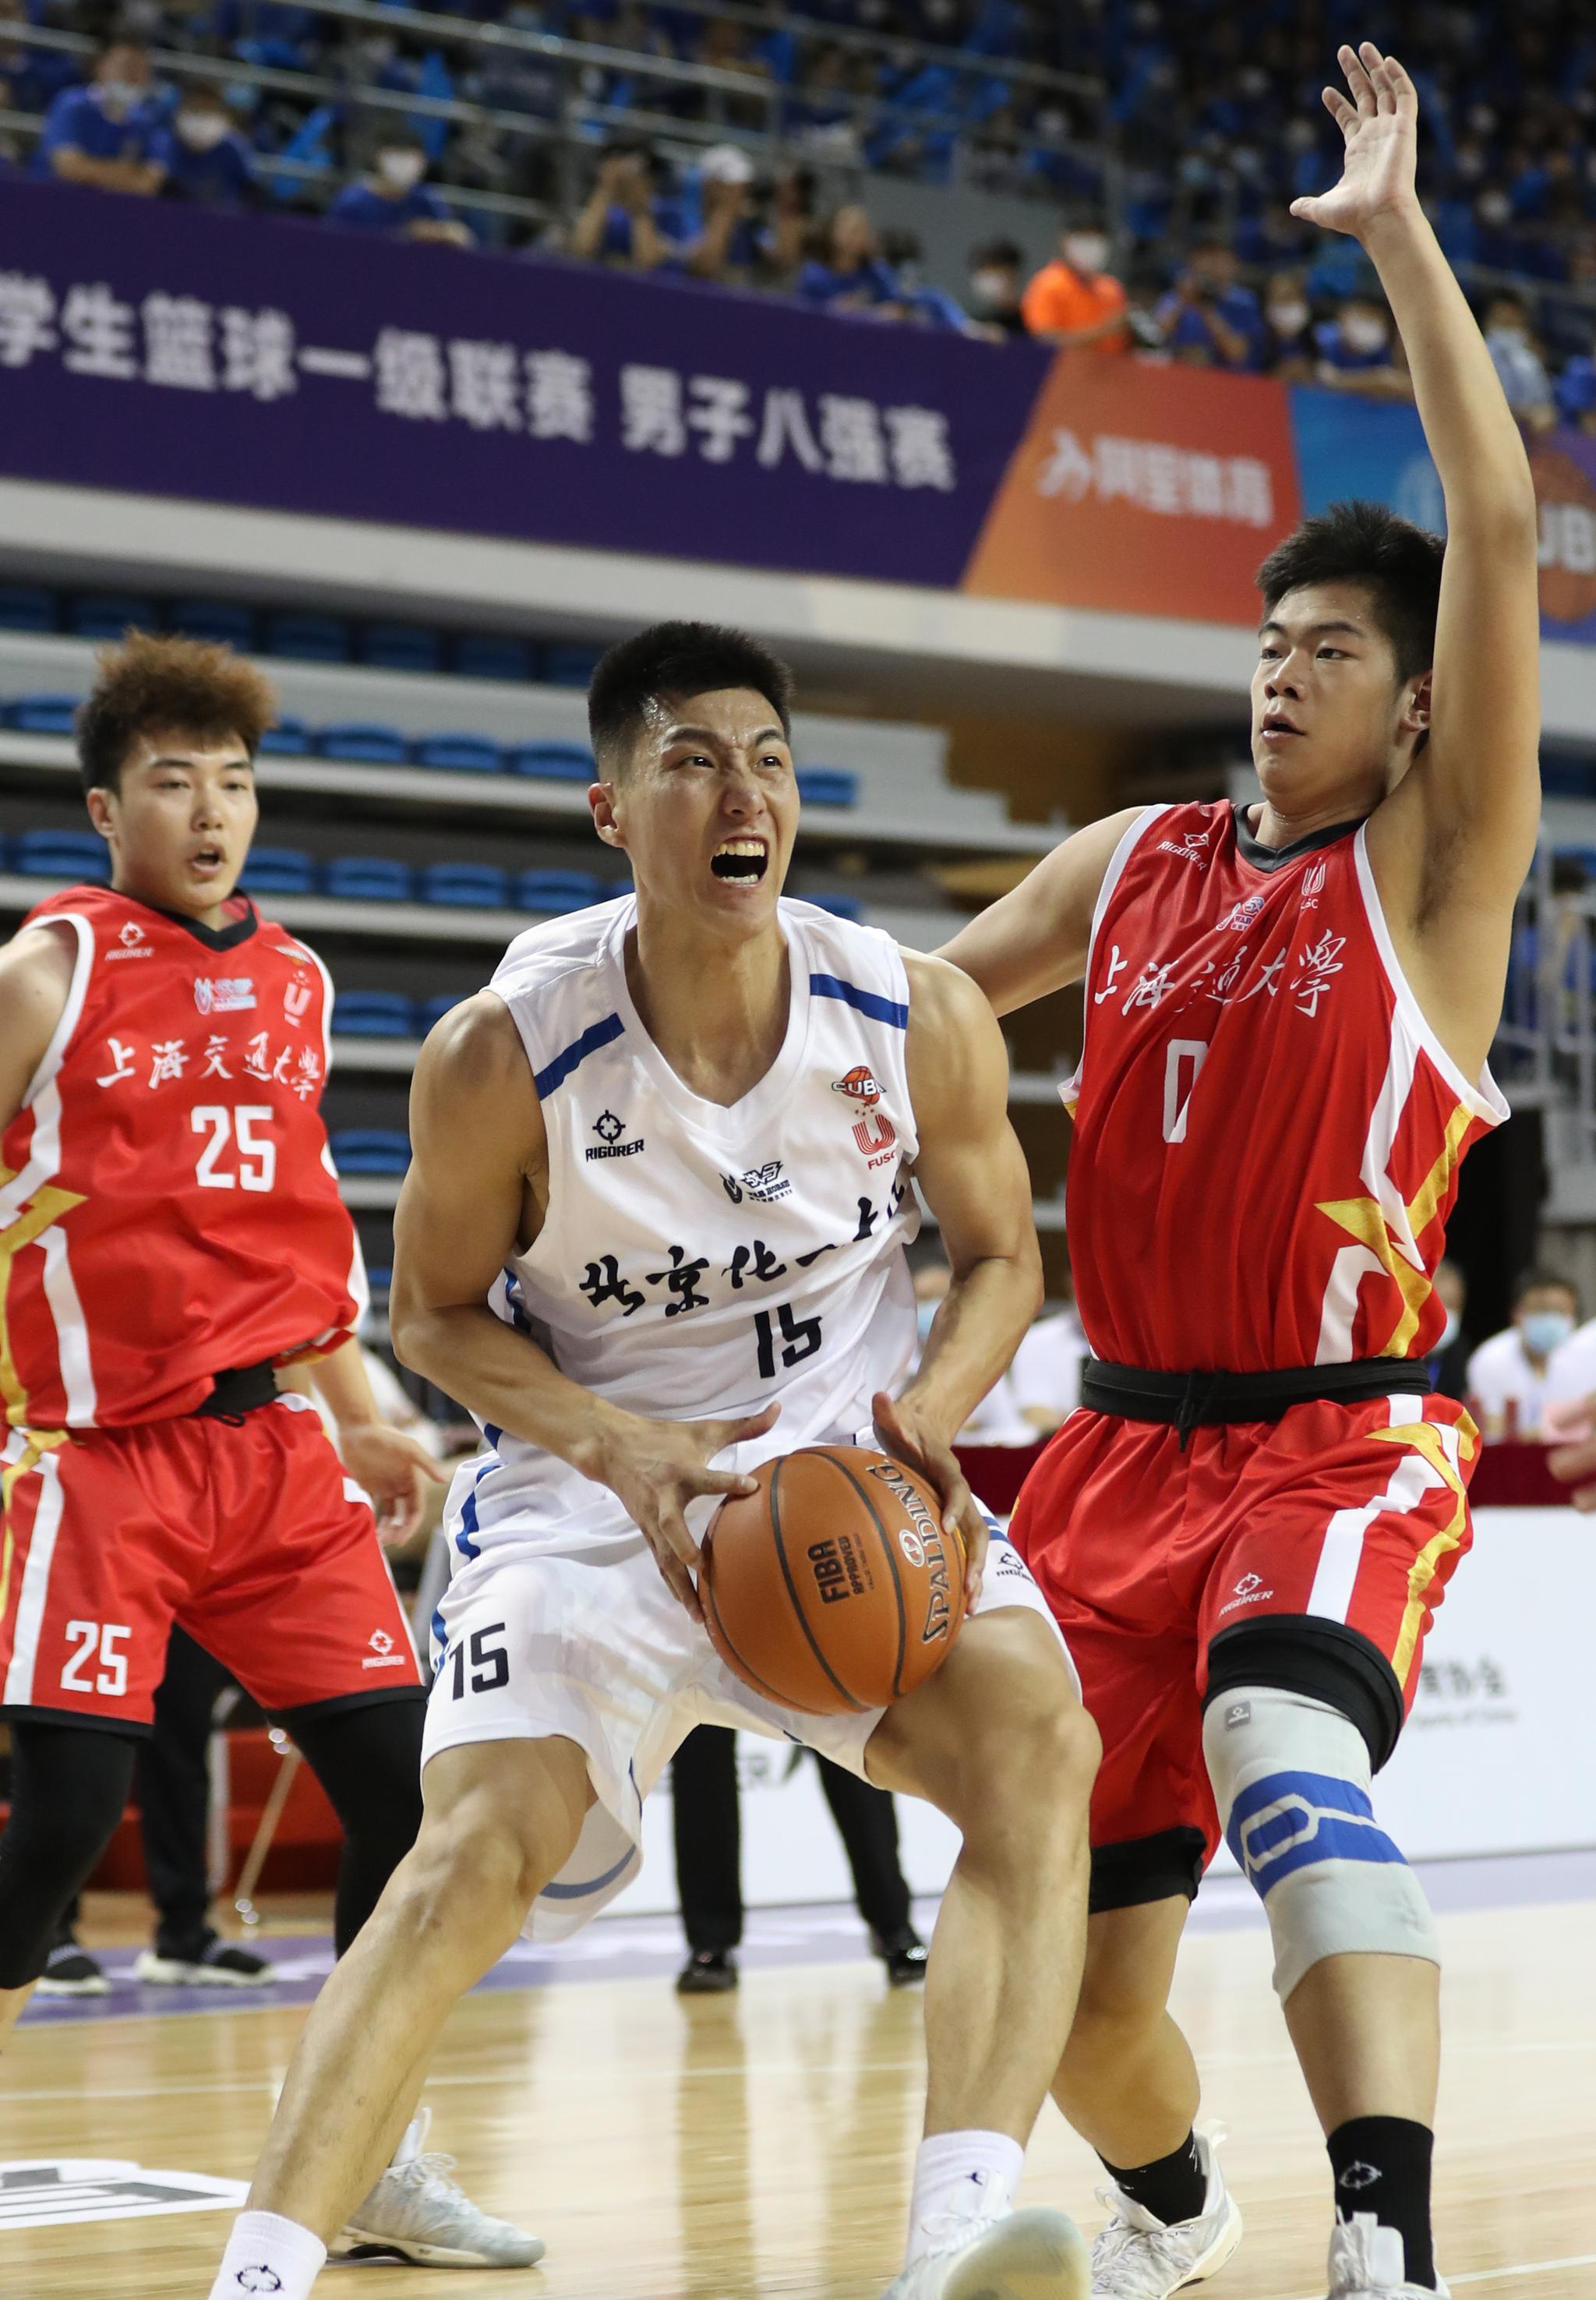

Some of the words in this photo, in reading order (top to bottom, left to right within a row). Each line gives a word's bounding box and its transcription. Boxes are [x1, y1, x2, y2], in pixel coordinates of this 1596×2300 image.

[0, 269, 595, 444] 学生篮球一级联赛
[620, 363, 957, 493] 男子八强赛
[1162, 1039, 1209, 1143] 0
[191, 1105, 276, 1192] 25
[585, 1139, 644, 1163] RIGORER
[754, 1302, 822, 1379] 15
[807, 1539, 850, 1604] FIBA
[866, 1459, 952, 1645] SPALDING
[61, 1620, 131, 1695] 25
[450, 1623, 510, 1700] 15
